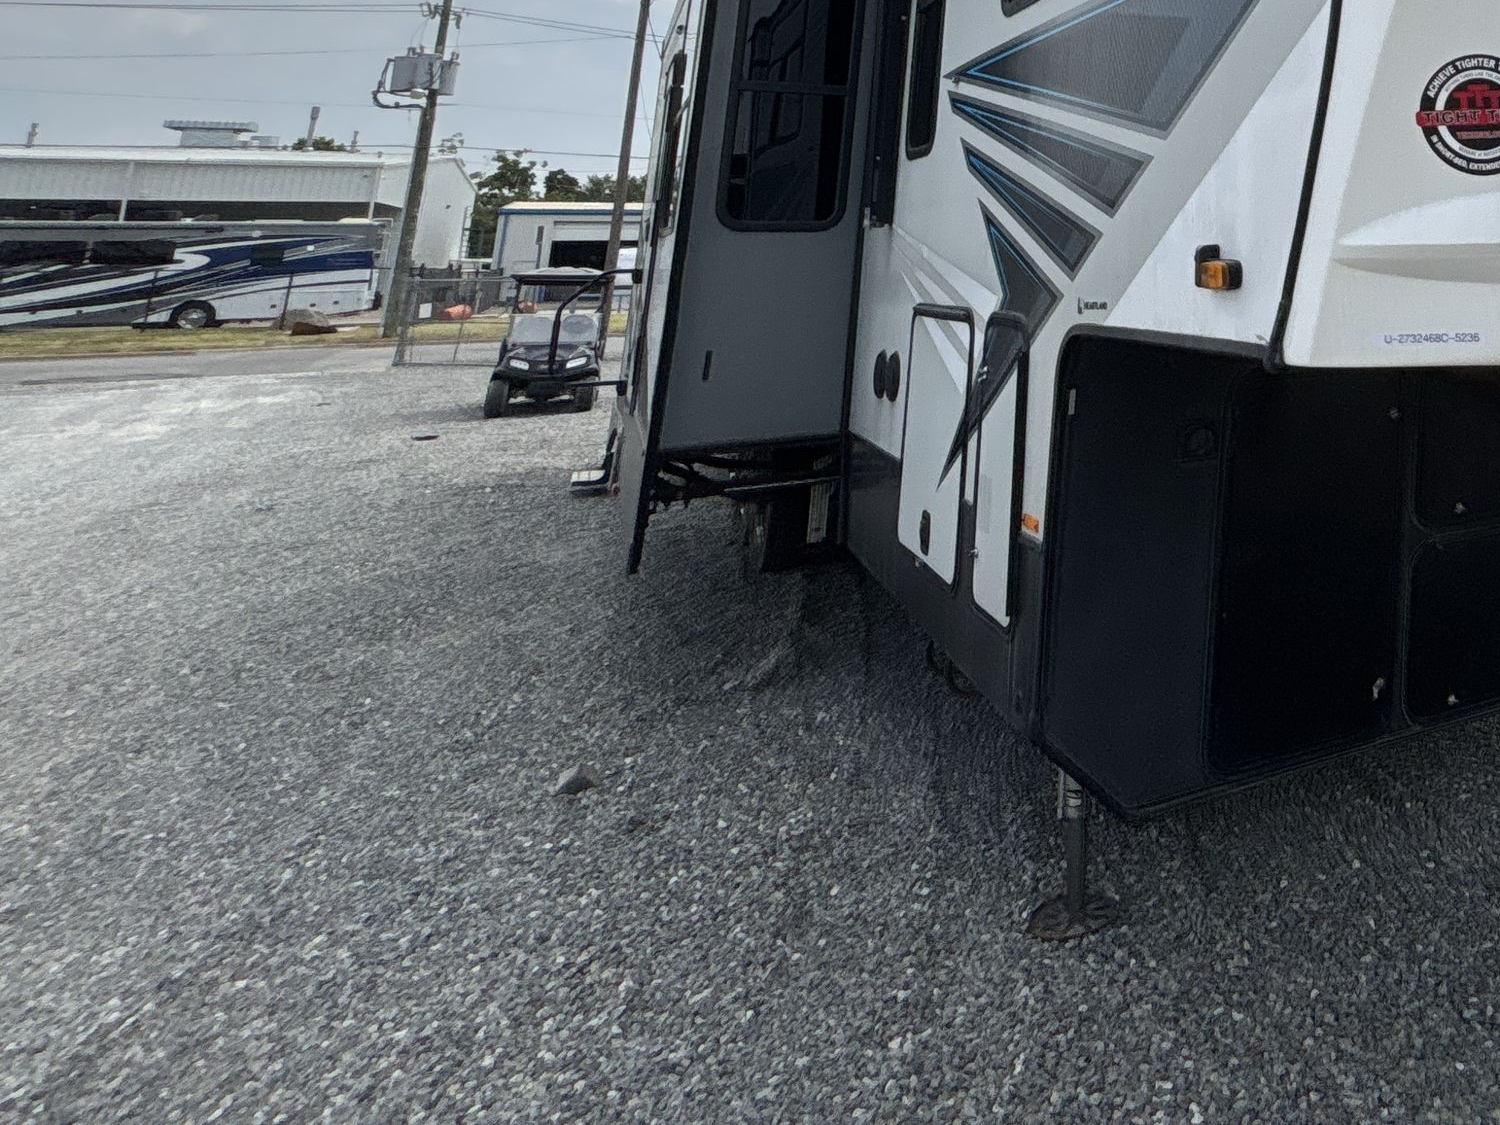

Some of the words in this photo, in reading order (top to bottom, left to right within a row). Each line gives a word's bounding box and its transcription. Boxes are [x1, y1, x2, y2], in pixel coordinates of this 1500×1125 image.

[1426, 65, 1456, 98] ACHIEVE
[1455, 57, 1496, 70] TIGHTER
[1423, 109, 1480, 125] TIGHT
